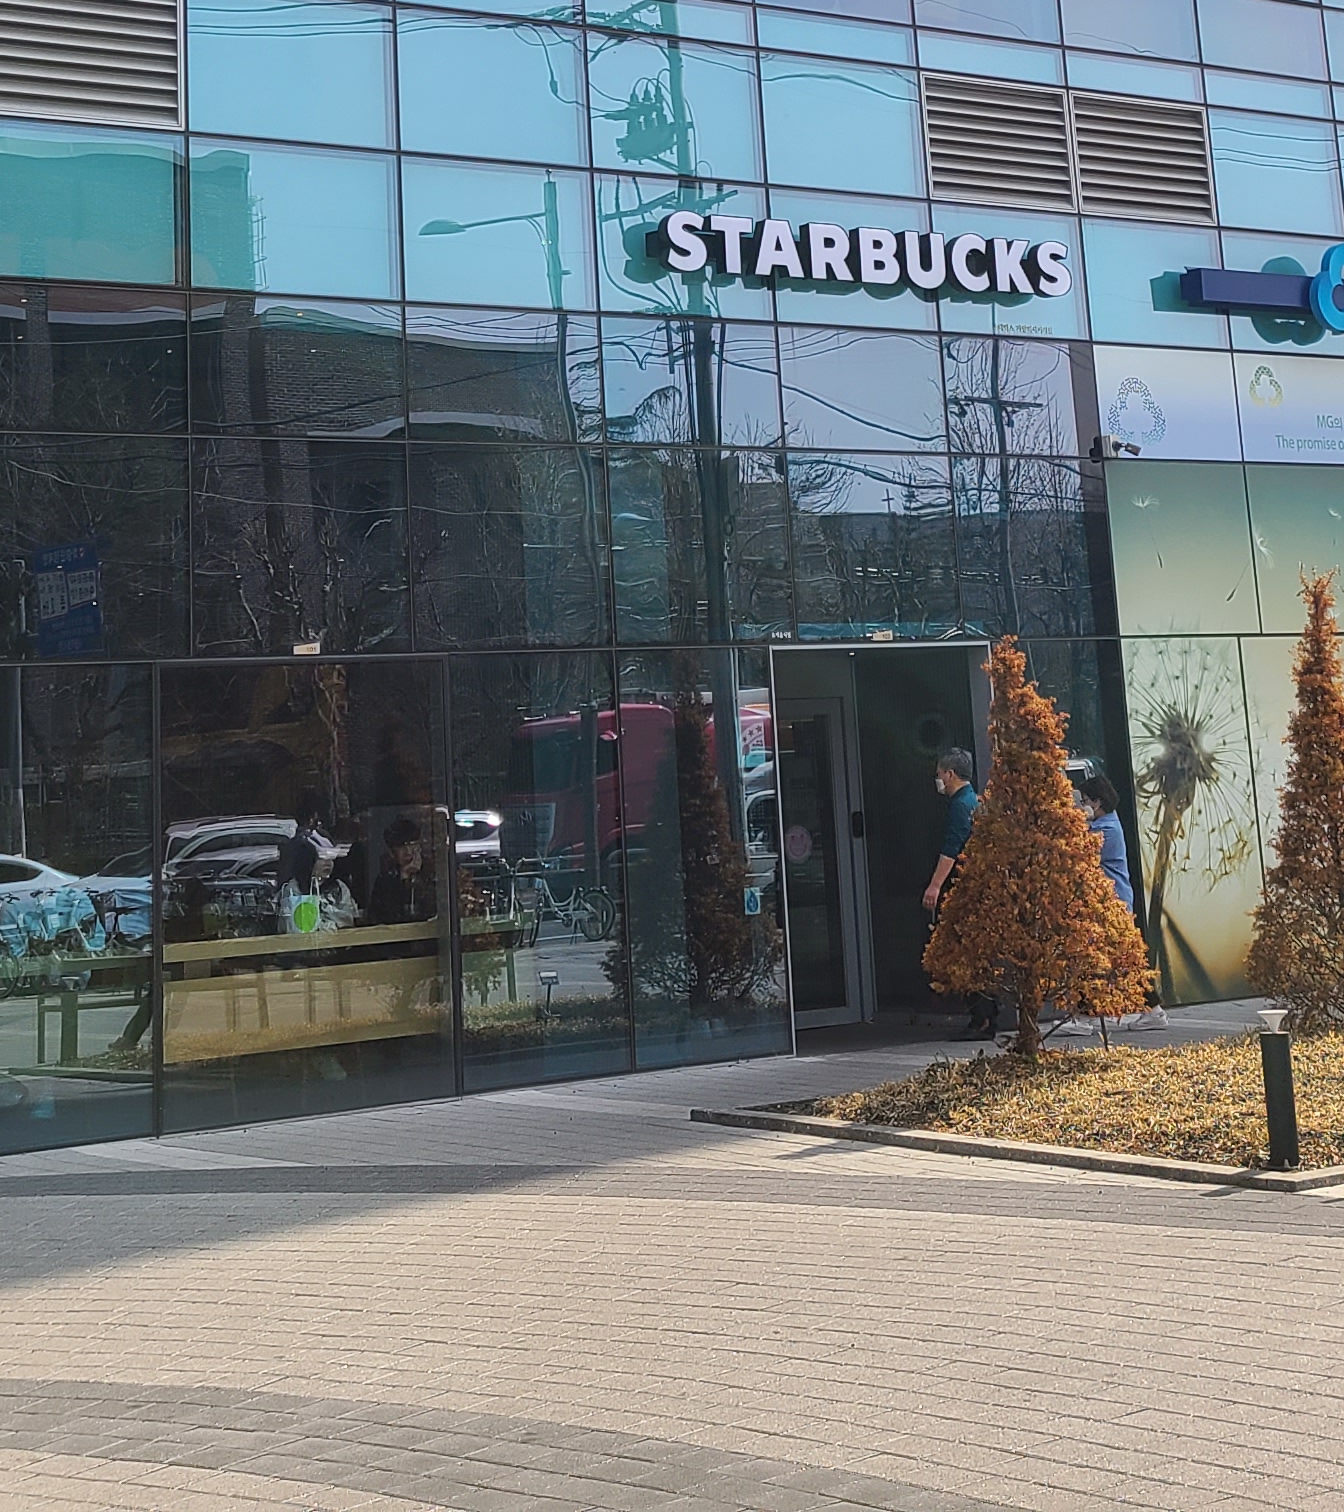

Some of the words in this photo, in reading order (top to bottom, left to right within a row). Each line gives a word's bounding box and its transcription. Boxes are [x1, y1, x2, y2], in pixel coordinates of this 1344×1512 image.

[665, 209, 1073, 299] STARBUCKS
[1316, 414, 1343, 431] MG의
[1275, 434, 1295, 450] The
[1296, 436, 1338, 453] promise
